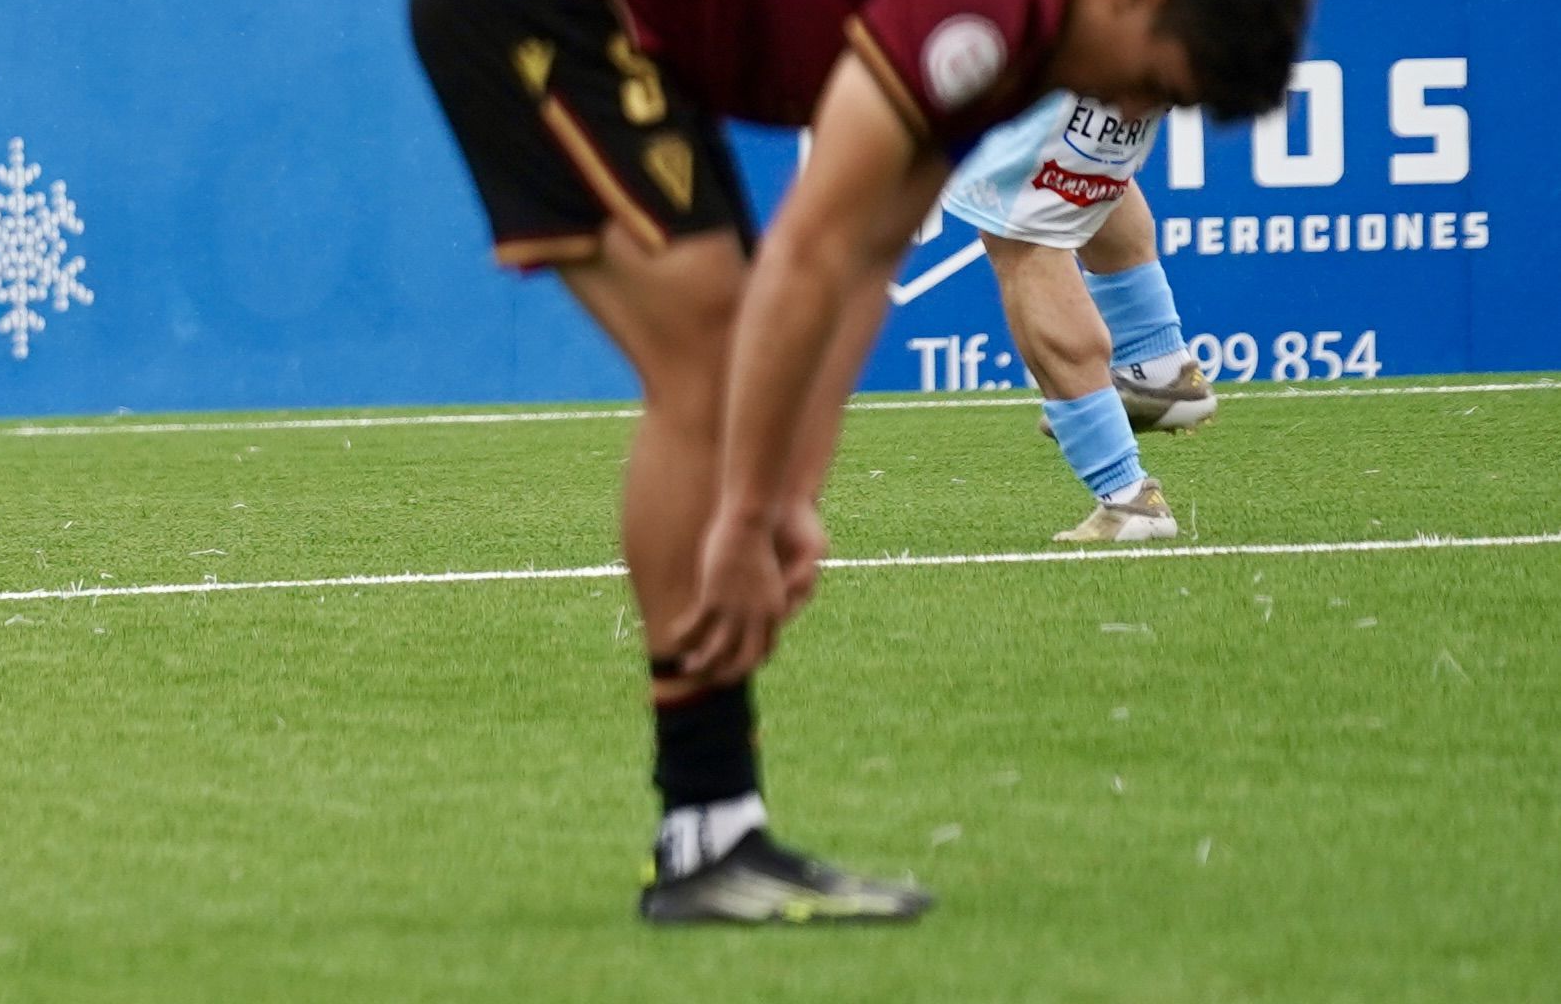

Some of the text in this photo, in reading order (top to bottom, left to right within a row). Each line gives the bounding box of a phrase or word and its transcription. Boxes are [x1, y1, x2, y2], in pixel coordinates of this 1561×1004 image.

[1067, 105, 1094, 138] EL
[1162, 211, 1489, 255] PERACIONES
[1272, 330, 1383, 382] 854
